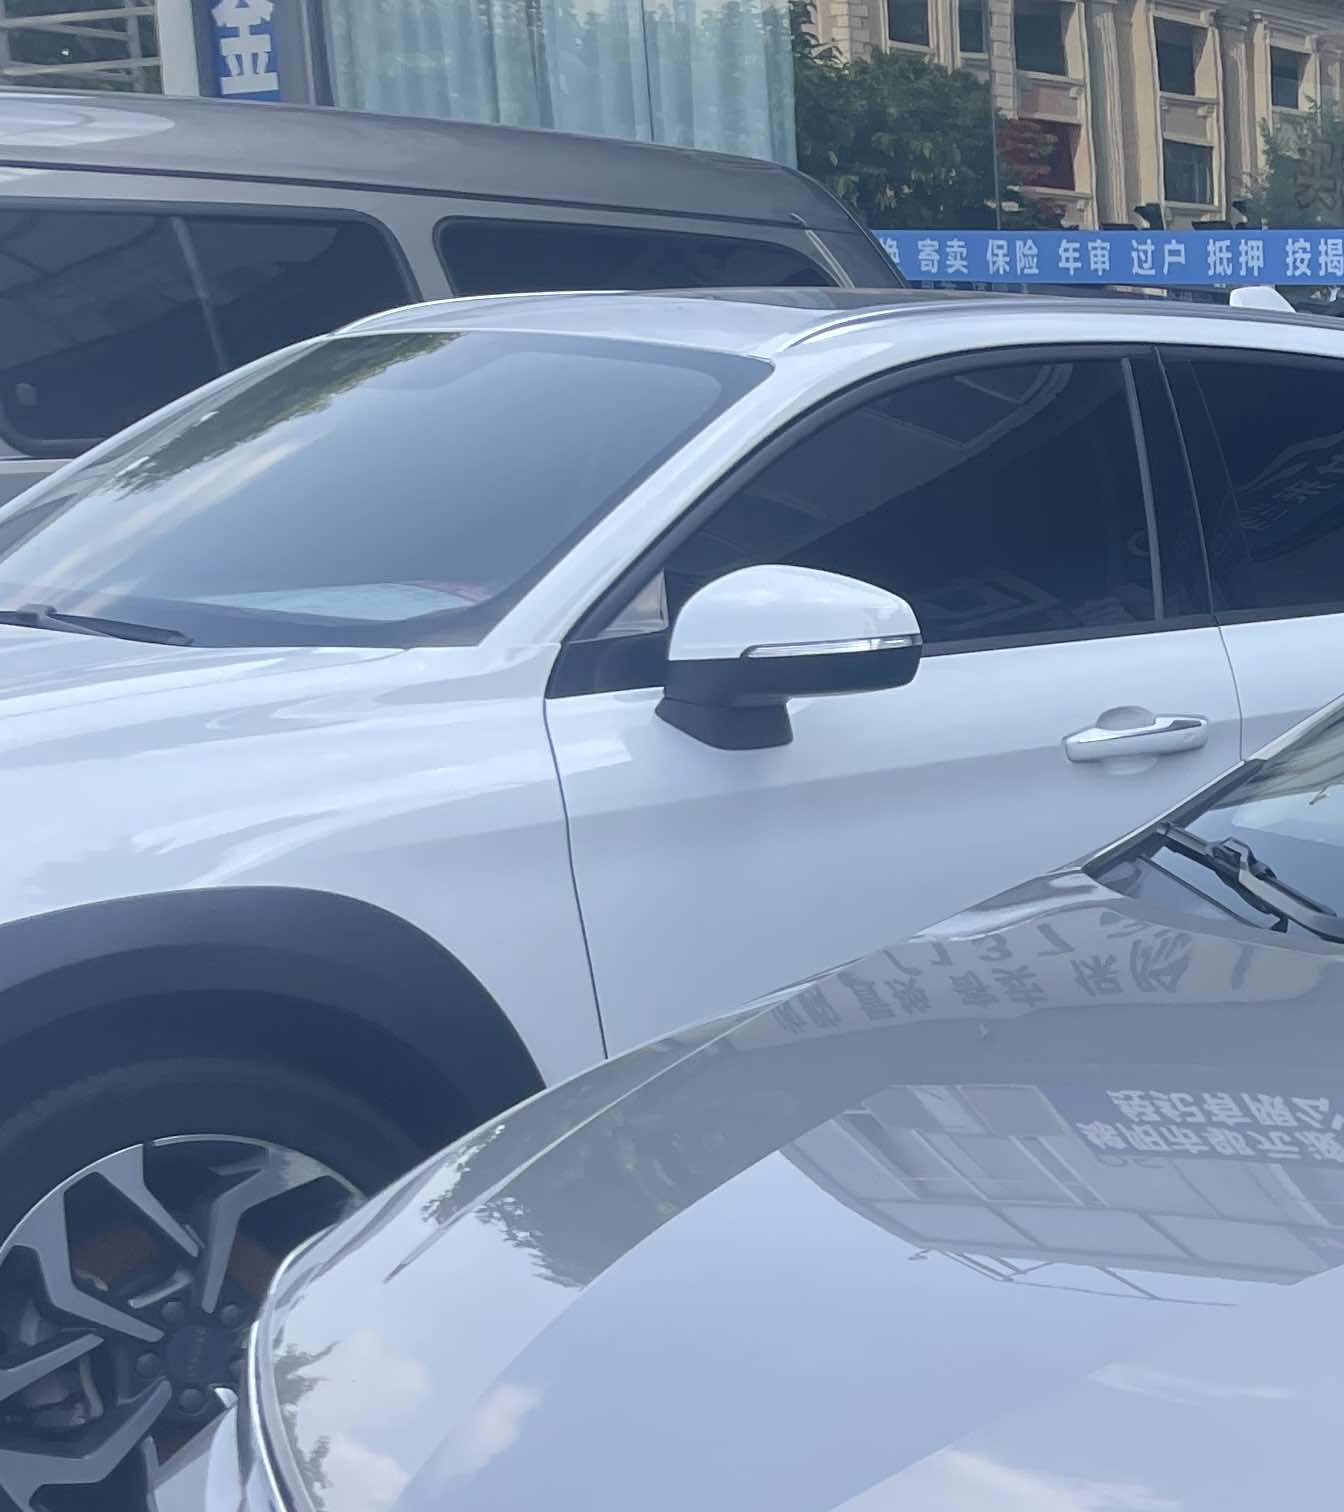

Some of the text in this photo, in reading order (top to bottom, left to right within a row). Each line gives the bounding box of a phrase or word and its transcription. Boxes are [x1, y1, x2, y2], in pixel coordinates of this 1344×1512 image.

[210, 0, 279, 95] 金
[917, 238, 969, 275] 寄卖
[985, 238, 1040, 276] 保险
[1057, 238, 1112, 276] 年审
[1130, 238, 1187, 277] 过户
[1206, 238, 1265, 278] 抵押
[1285, 237, 1344, 278] 按揭
